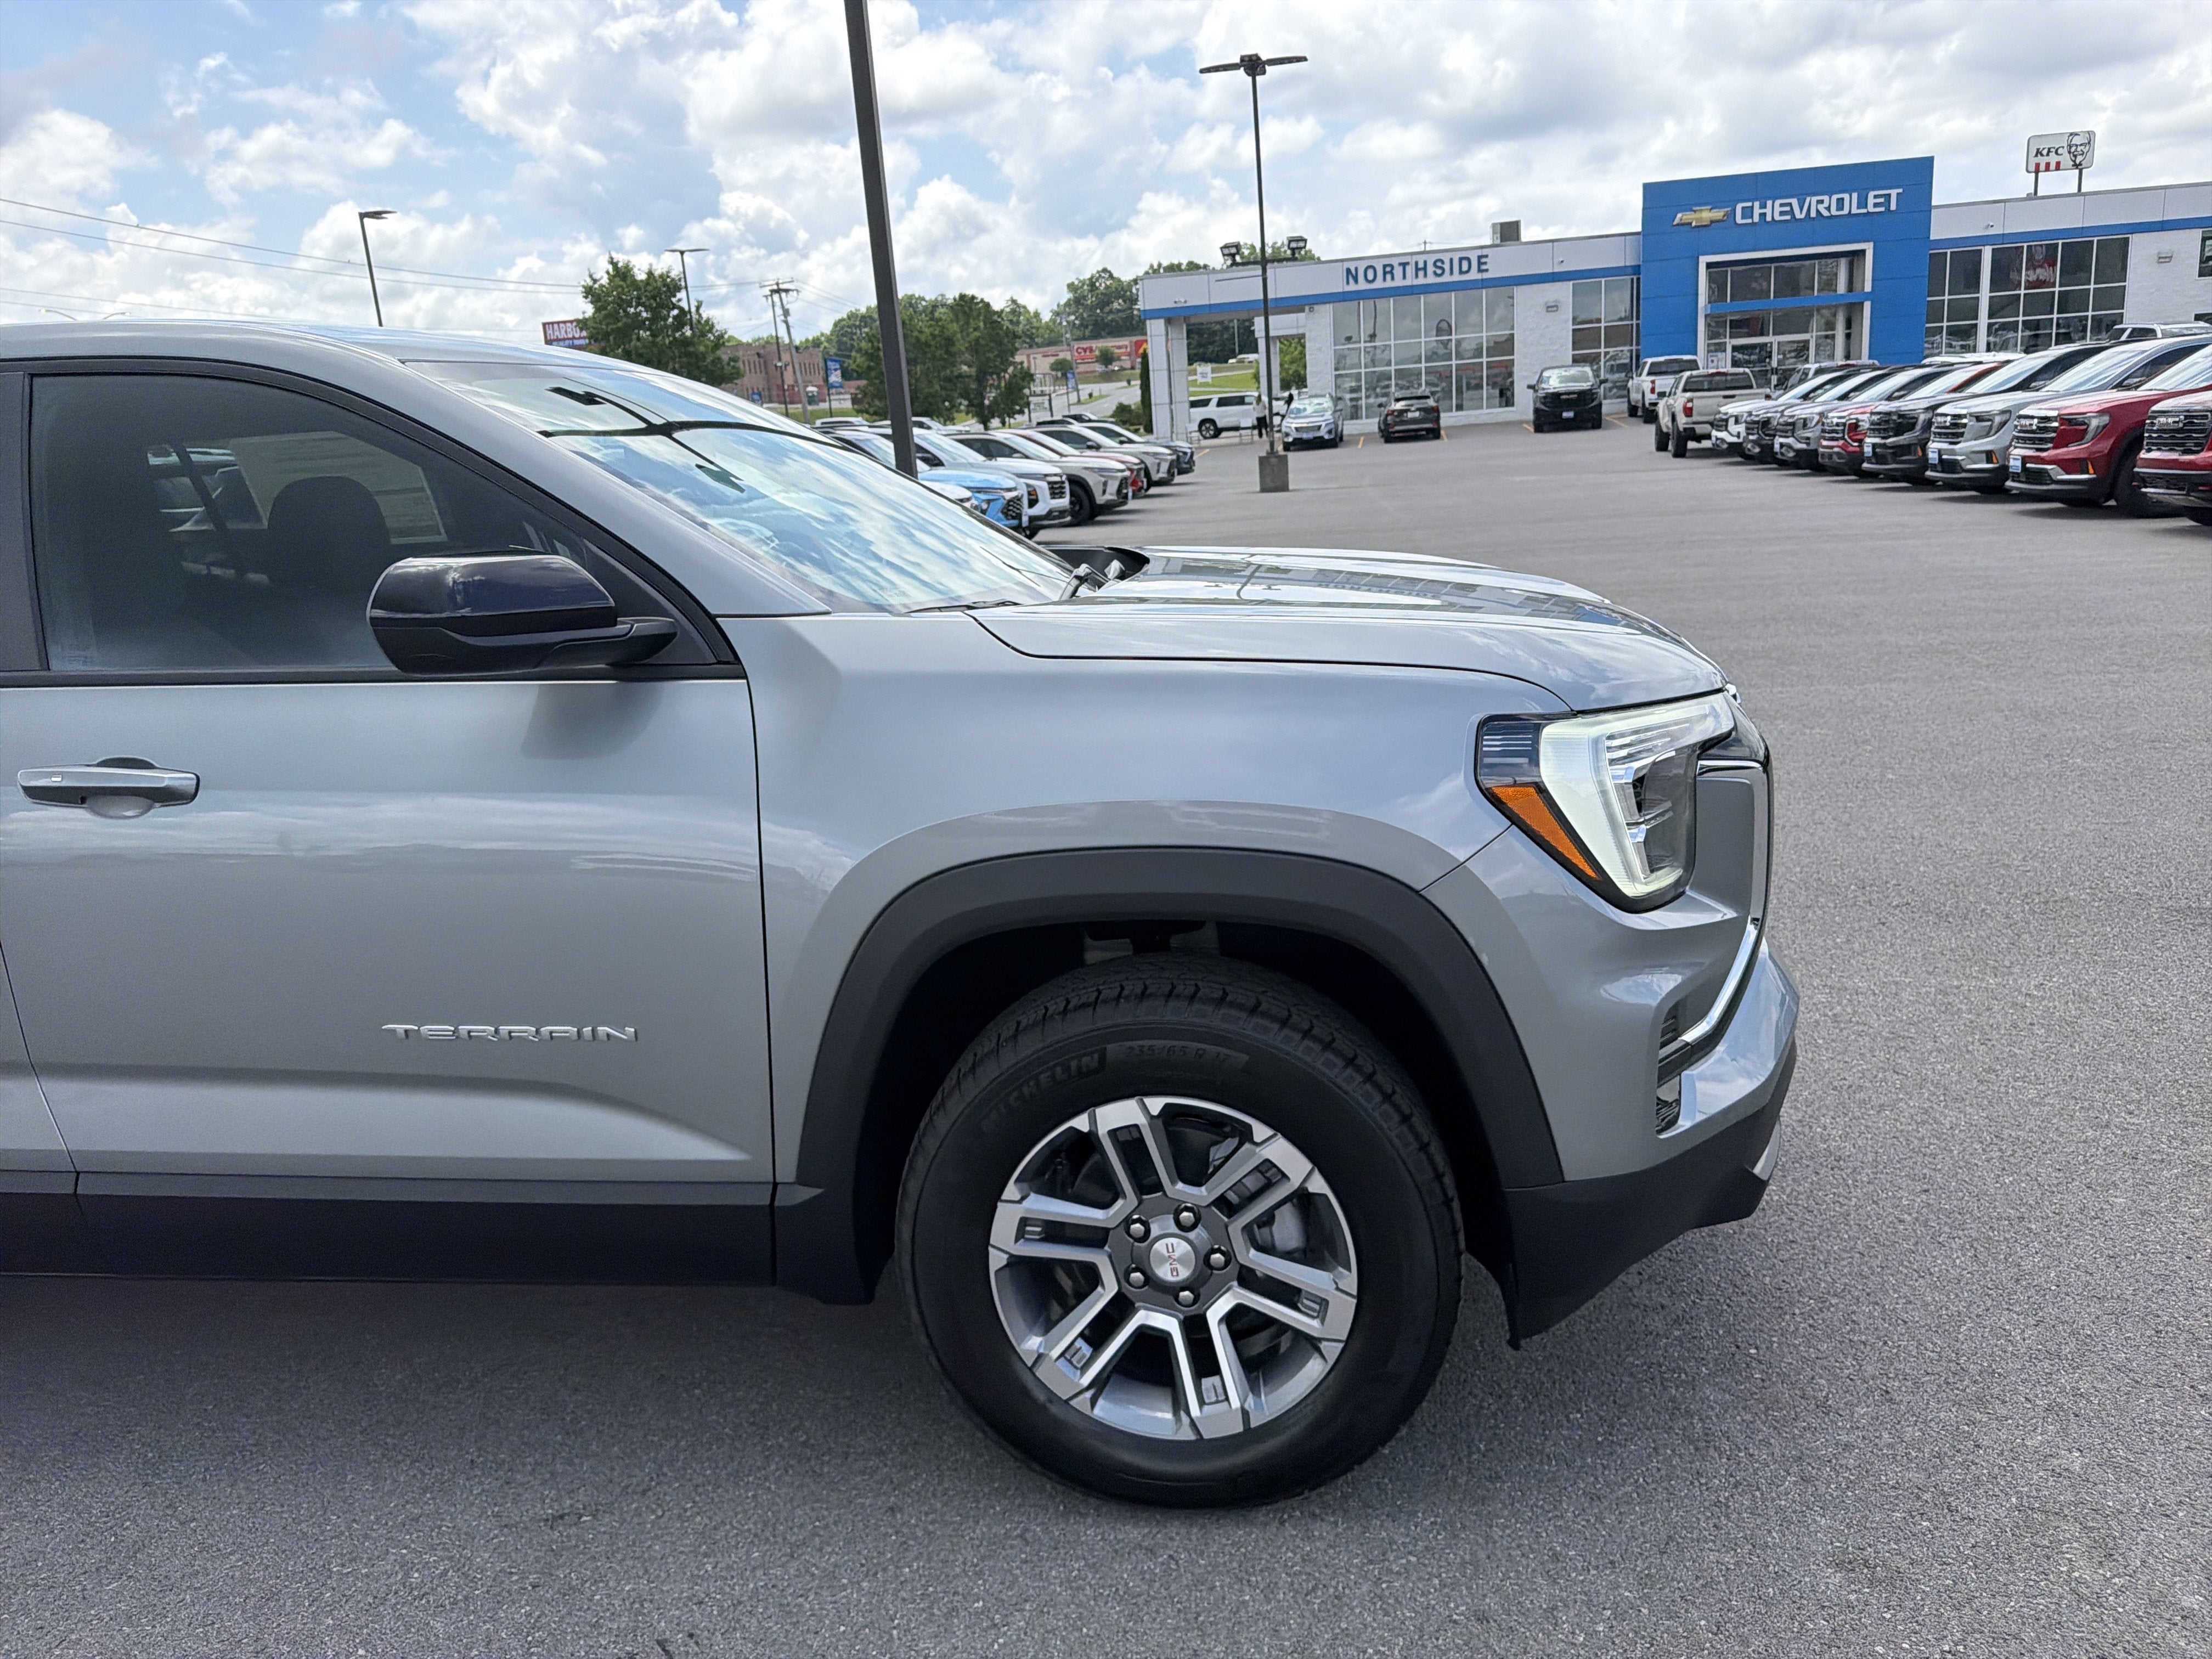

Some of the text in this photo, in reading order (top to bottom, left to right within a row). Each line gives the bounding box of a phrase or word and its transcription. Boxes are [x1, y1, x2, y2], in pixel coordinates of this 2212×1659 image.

[2034, 145, 2065, 157] KFC
[1735, 188, 1903, 224] CHEVROLET
[1346, 254, 1489, 285] NORTHSIDE
[382, 1024, 637, 1041] TERRAIN
[1193, 1047, 1206, 1060] R
[1165, 1242, 1180, 1278] GMC
